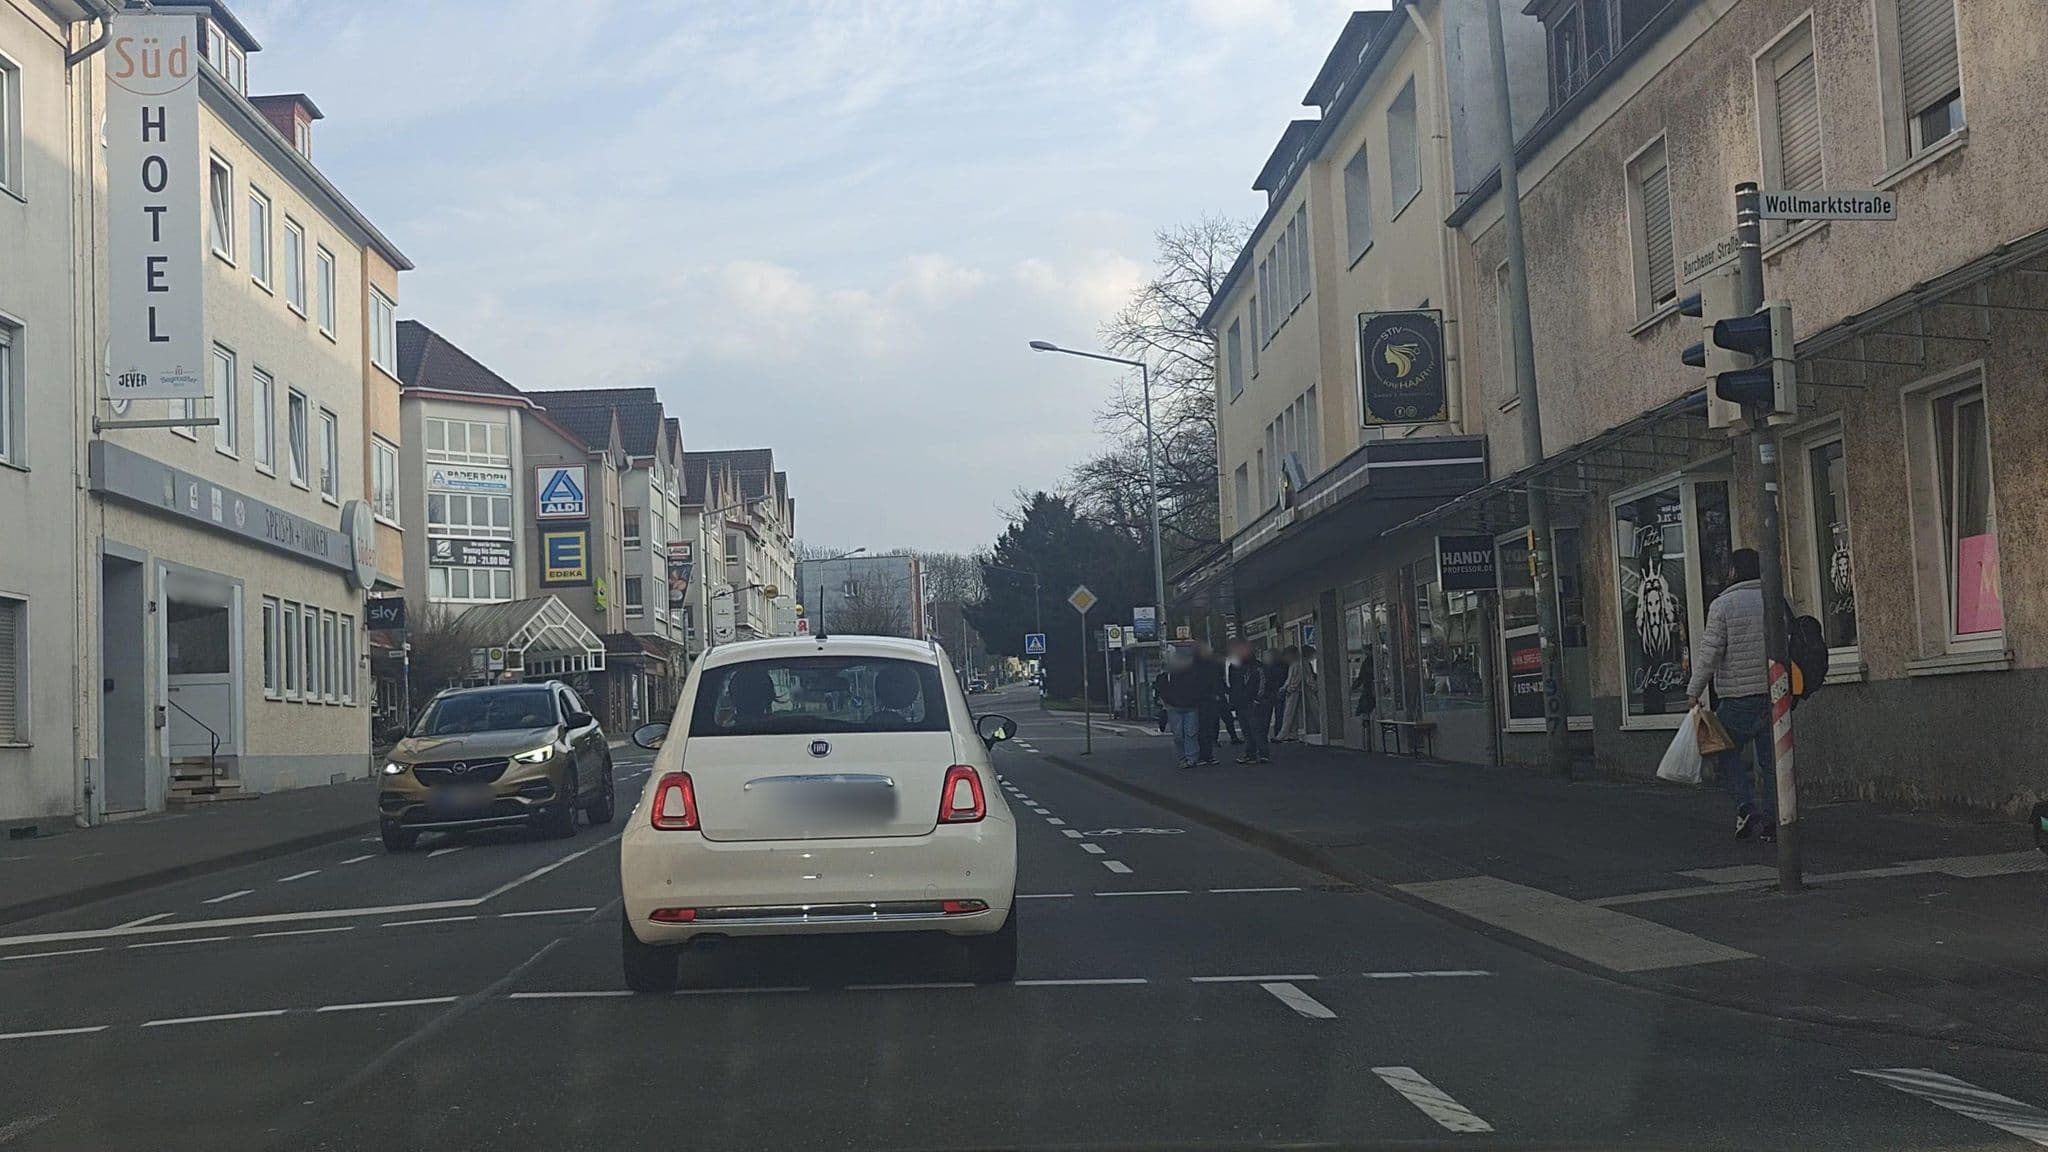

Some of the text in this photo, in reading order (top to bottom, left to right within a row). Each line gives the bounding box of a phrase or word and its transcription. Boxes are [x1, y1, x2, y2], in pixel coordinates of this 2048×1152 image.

[115, 36, 188, 79] Süd
[1765, 196, 1892, 214] Wollmarktstraße
[142, 106, 170, 342] HOTEL
[1717, 236, 1739, 259] Straße
[1381, 326, 1402, 340] STIV
[118, 373, 148, 388] JEVER
[545, 502, 580, 513] ALDI
[1442, 550, 1492, 565] HANDY
[549, 570, 583, 578] EDEKA
[371, 605, 399, 621] sky
[813, 743, 827, 752] FIAT
